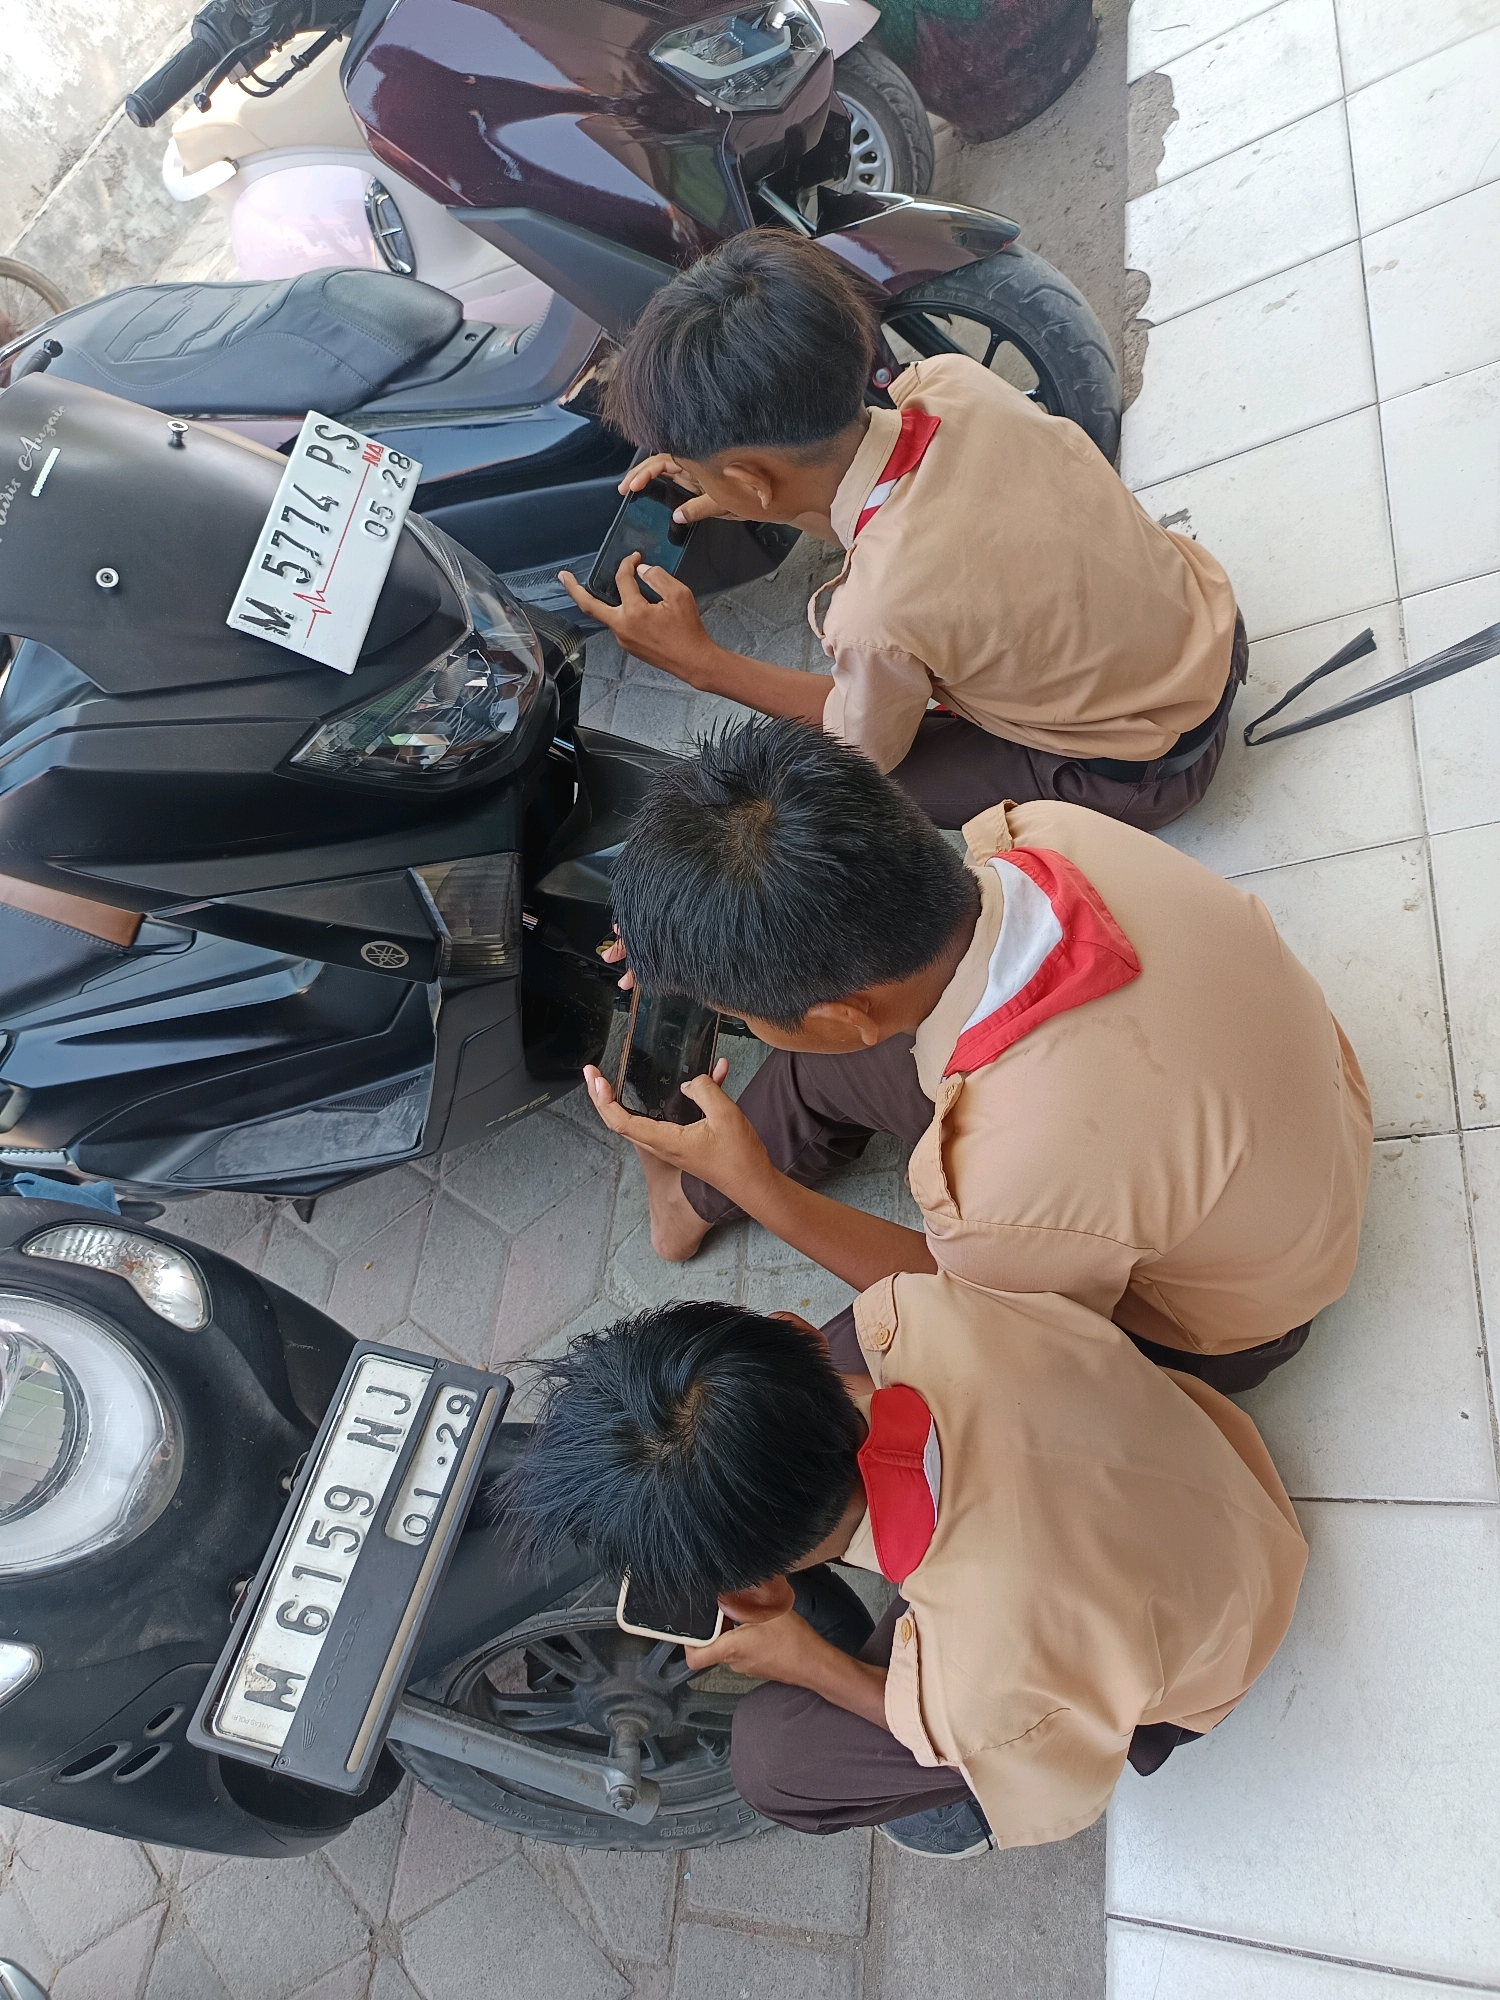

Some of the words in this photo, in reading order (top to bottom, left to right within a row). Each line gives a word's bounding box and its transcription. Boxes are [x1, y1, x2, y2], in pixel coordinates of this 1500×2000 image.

[305, 424, 360, 474] PS
[361, 442, 385, 468] NA
[260, 483, 339, 584] 5774
[239, 596, 295, 637] M
[243, 1662, 307, 1713] M
[275, 1484, 375, 1636] 6159
[346, 1385, 412, 1452] NJ
[312, 1609, 366, 1718] HONDA
[491, 1801, 534, 1822] ROTATION
